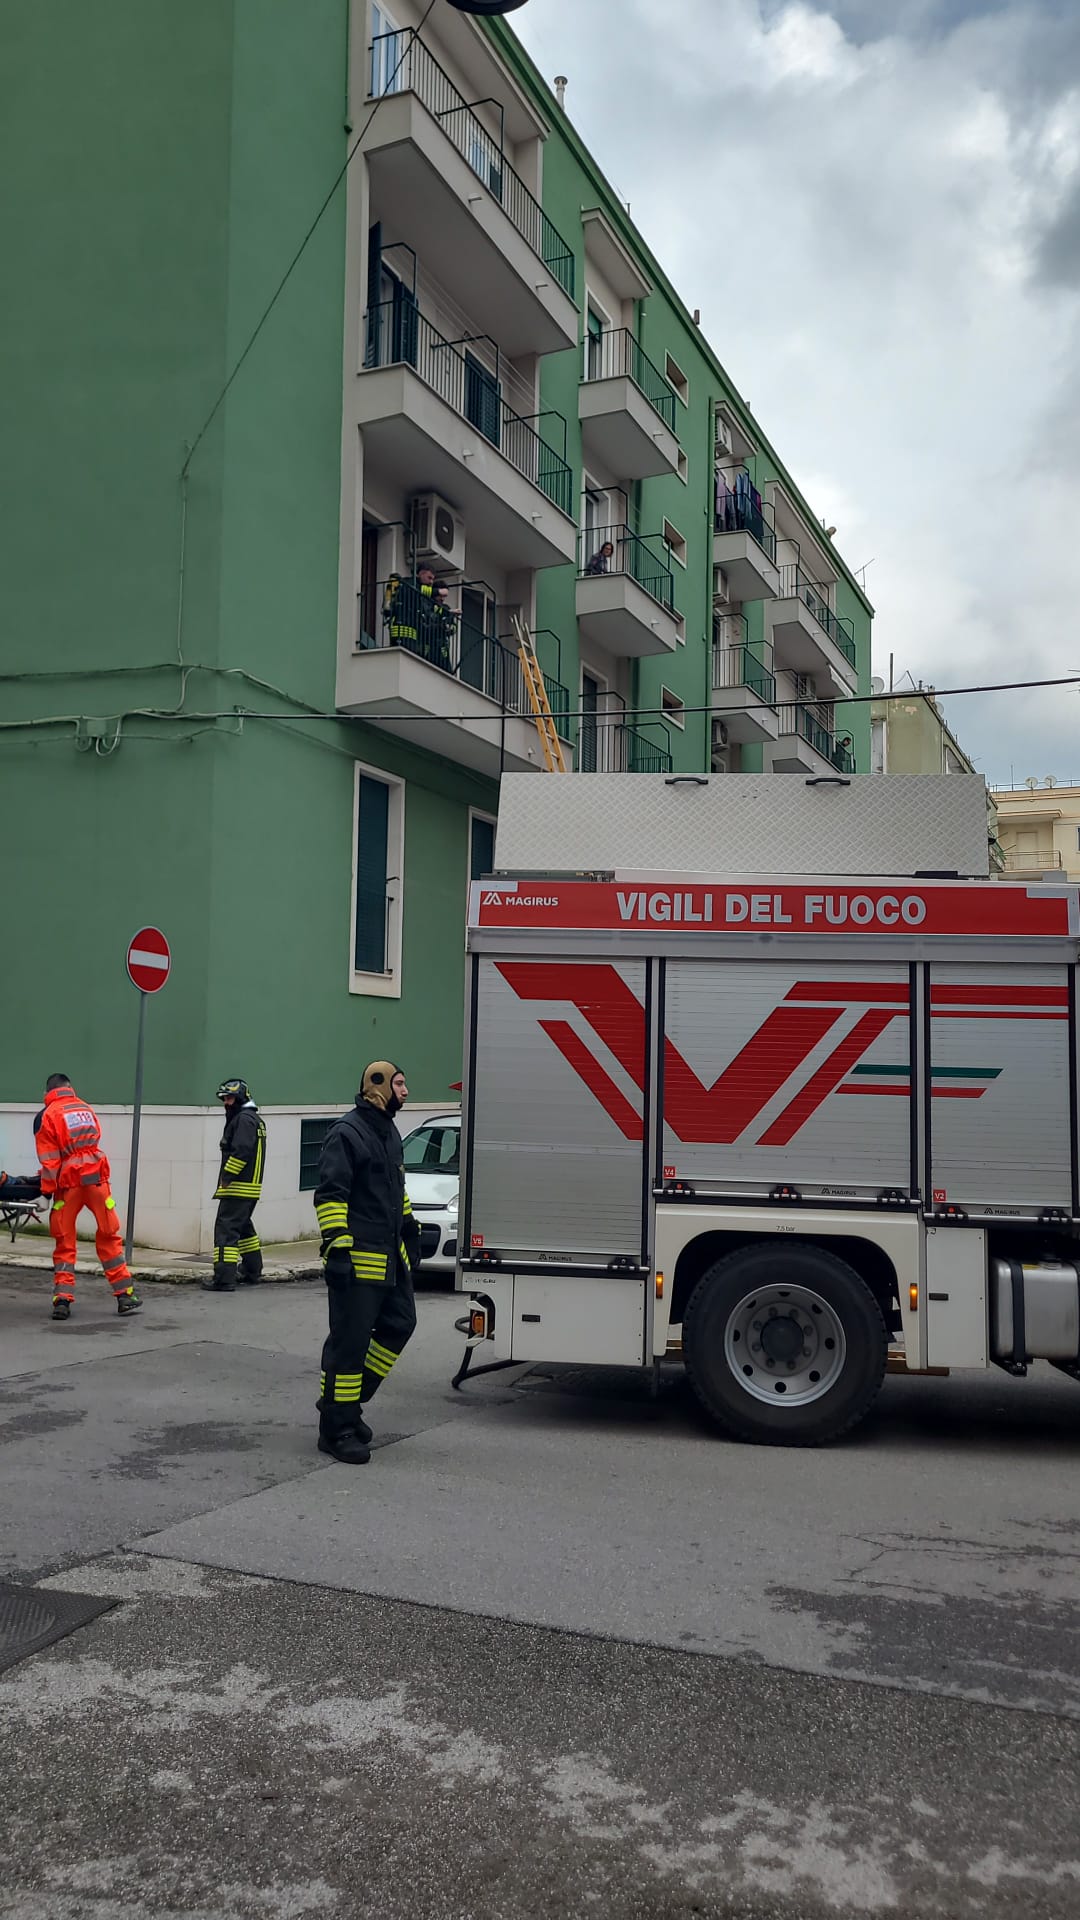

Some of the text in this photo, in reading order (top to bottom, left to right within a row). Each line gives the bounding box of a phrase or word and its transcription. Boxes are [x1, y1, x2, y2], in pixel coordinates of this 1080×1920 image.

[506, 897, 558, 906] MAGIRUS
[616, 892, 927, 925] VIGILI DEL FUOCO
[664, 1168, 675, 1176] V4
[935, 1192, 945, 1200] V2
